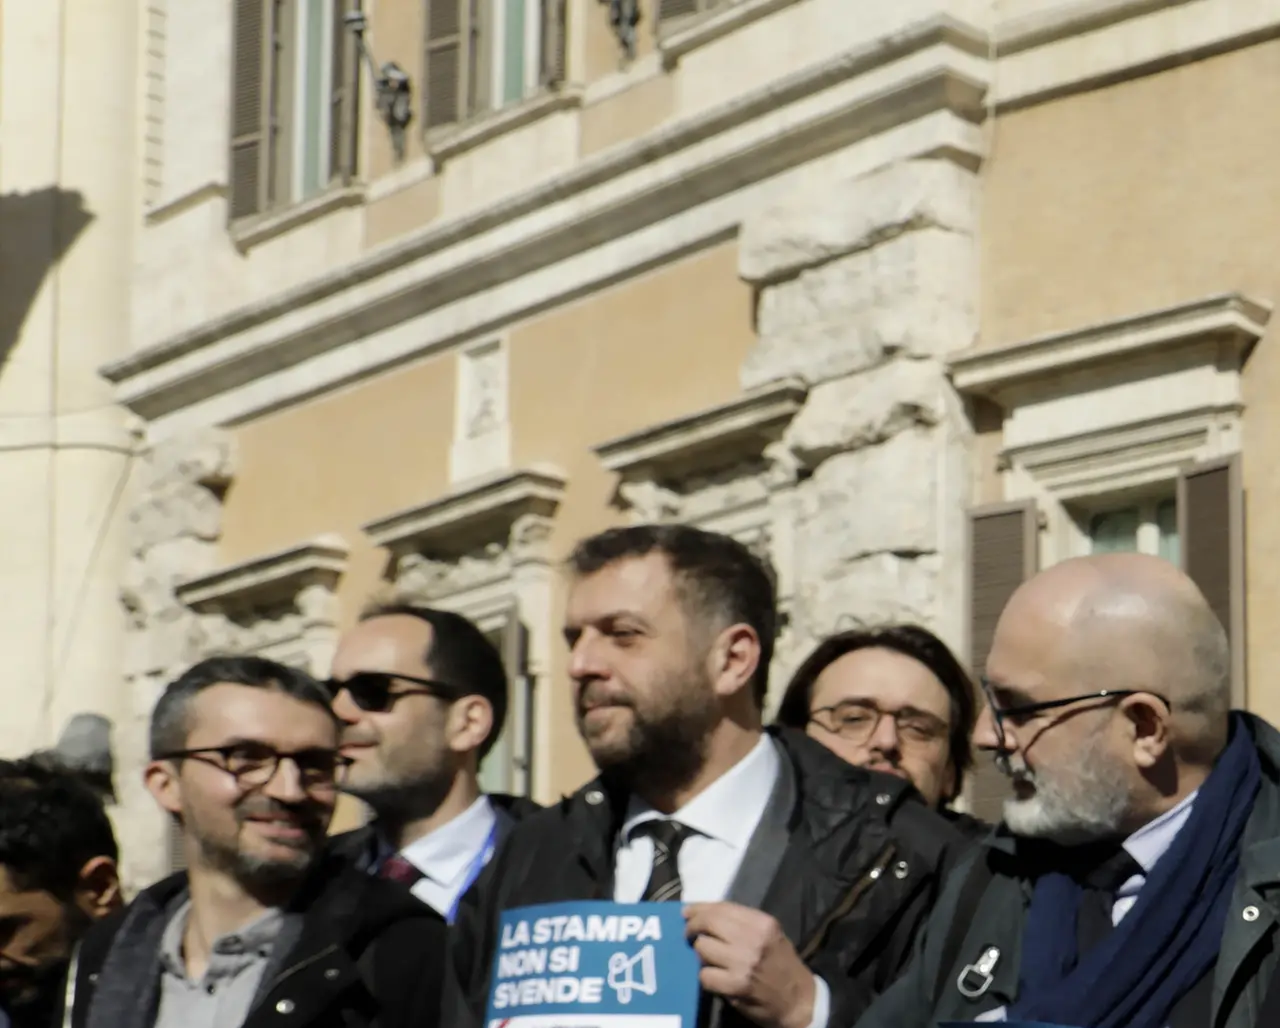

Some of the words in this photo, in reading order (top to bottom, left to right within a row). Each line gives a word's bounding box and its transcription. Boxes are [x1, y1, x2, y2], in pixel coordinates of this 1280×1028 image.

[501, 920, 530, 949] LA
[532, 914, 662, 944] STAMPA
[497, 948, 547, 978] NON
[549, 945, 580, 973] SI
[493, 976, 604, 1009] SVENDE
